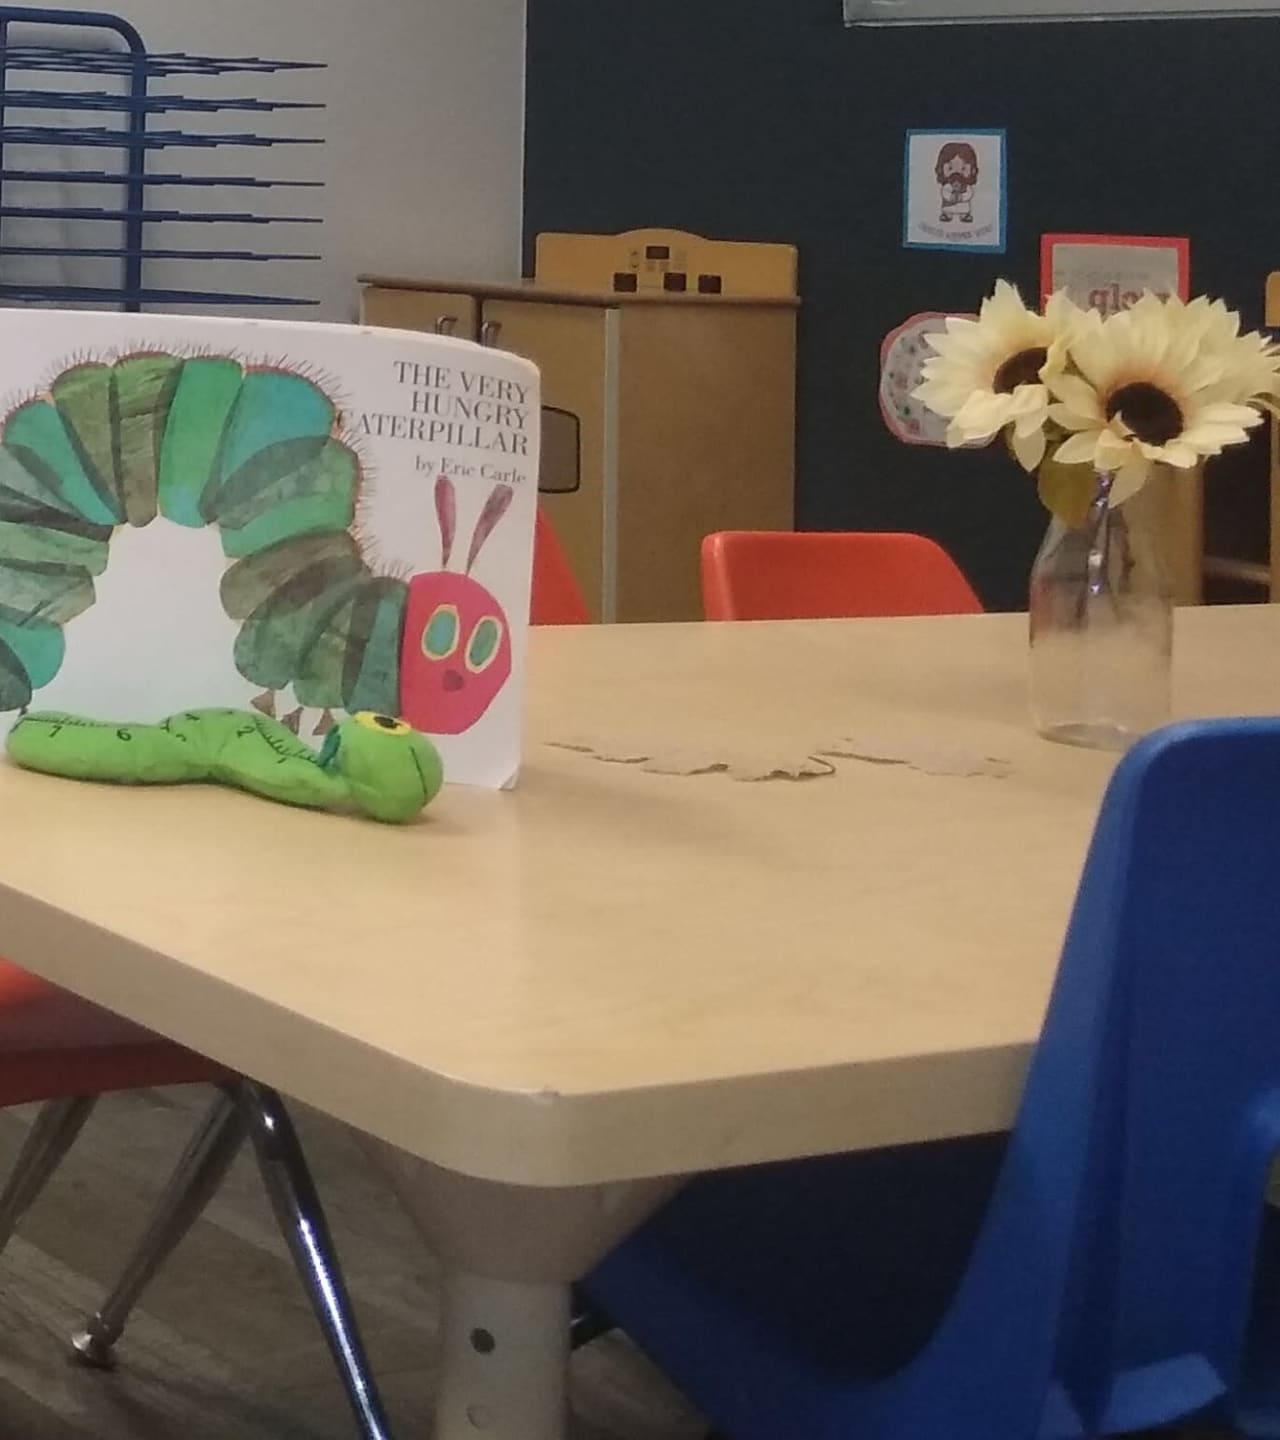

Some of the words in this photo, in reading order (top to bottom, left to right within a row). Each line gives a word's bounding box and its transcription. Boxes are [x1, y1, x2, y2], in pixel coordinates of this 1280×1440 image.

[393, 360, 451, 389] THE
[460, 371, 530, 404] VERY
[412, 391, 530, 430] HUNGRY
[337, 409, 529, 456] CATERPILLAR
[415, 455, 433, 477] by
[440, 458, 477, 477] Eric
[480, 463, 526, 485] Carle
[117, 728, 132, 741] 6
